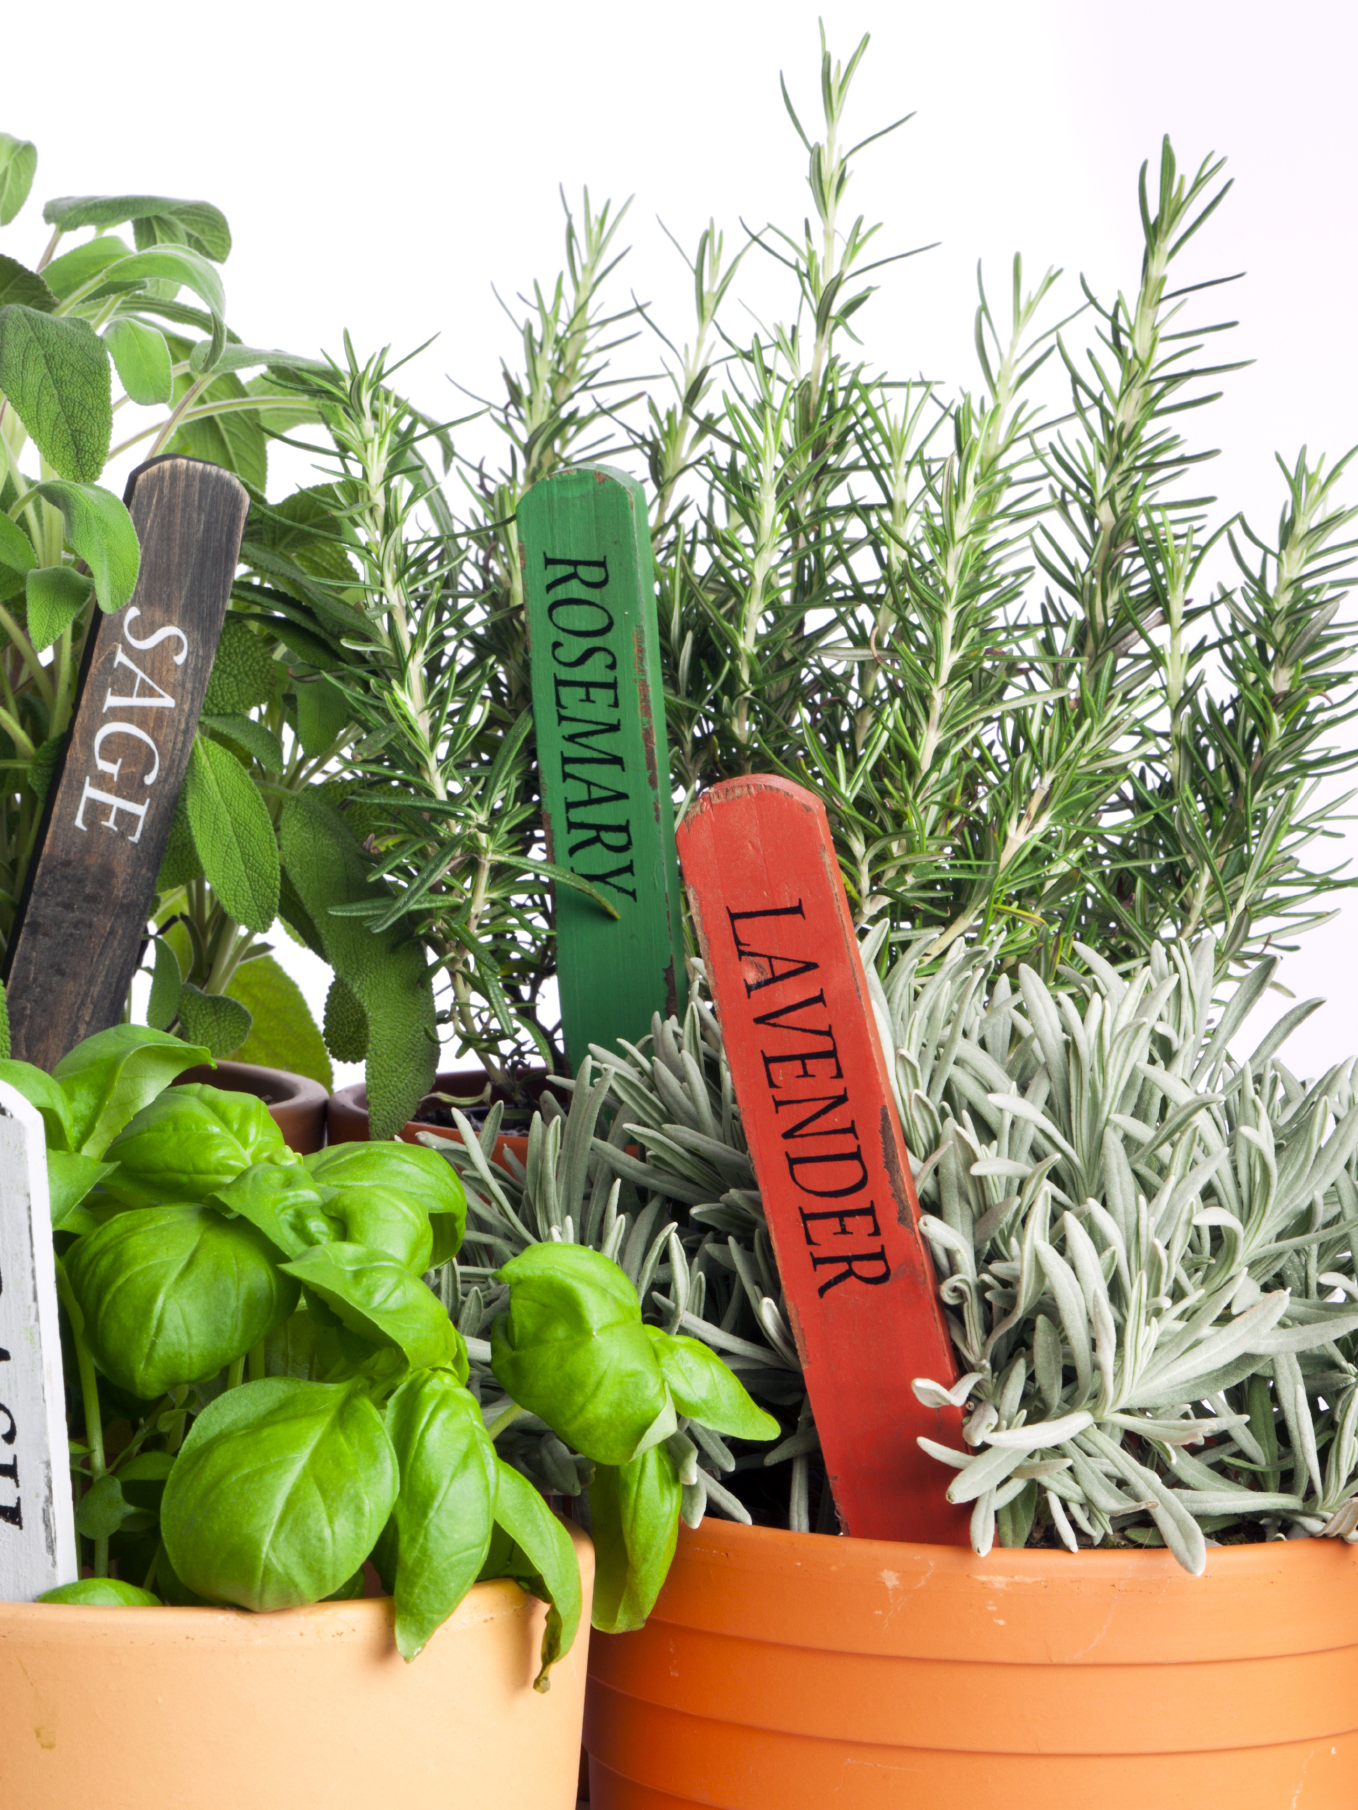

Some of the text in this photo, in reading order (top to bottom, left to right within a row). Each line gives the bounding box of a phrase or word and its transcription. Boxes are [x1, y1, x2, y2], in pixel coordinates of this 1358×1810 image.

[74, 606, 189, 844] SAGE
[543, 551, 638, 903] ROSEMARY
[726, 897, 892, 1299] LAVENDER
